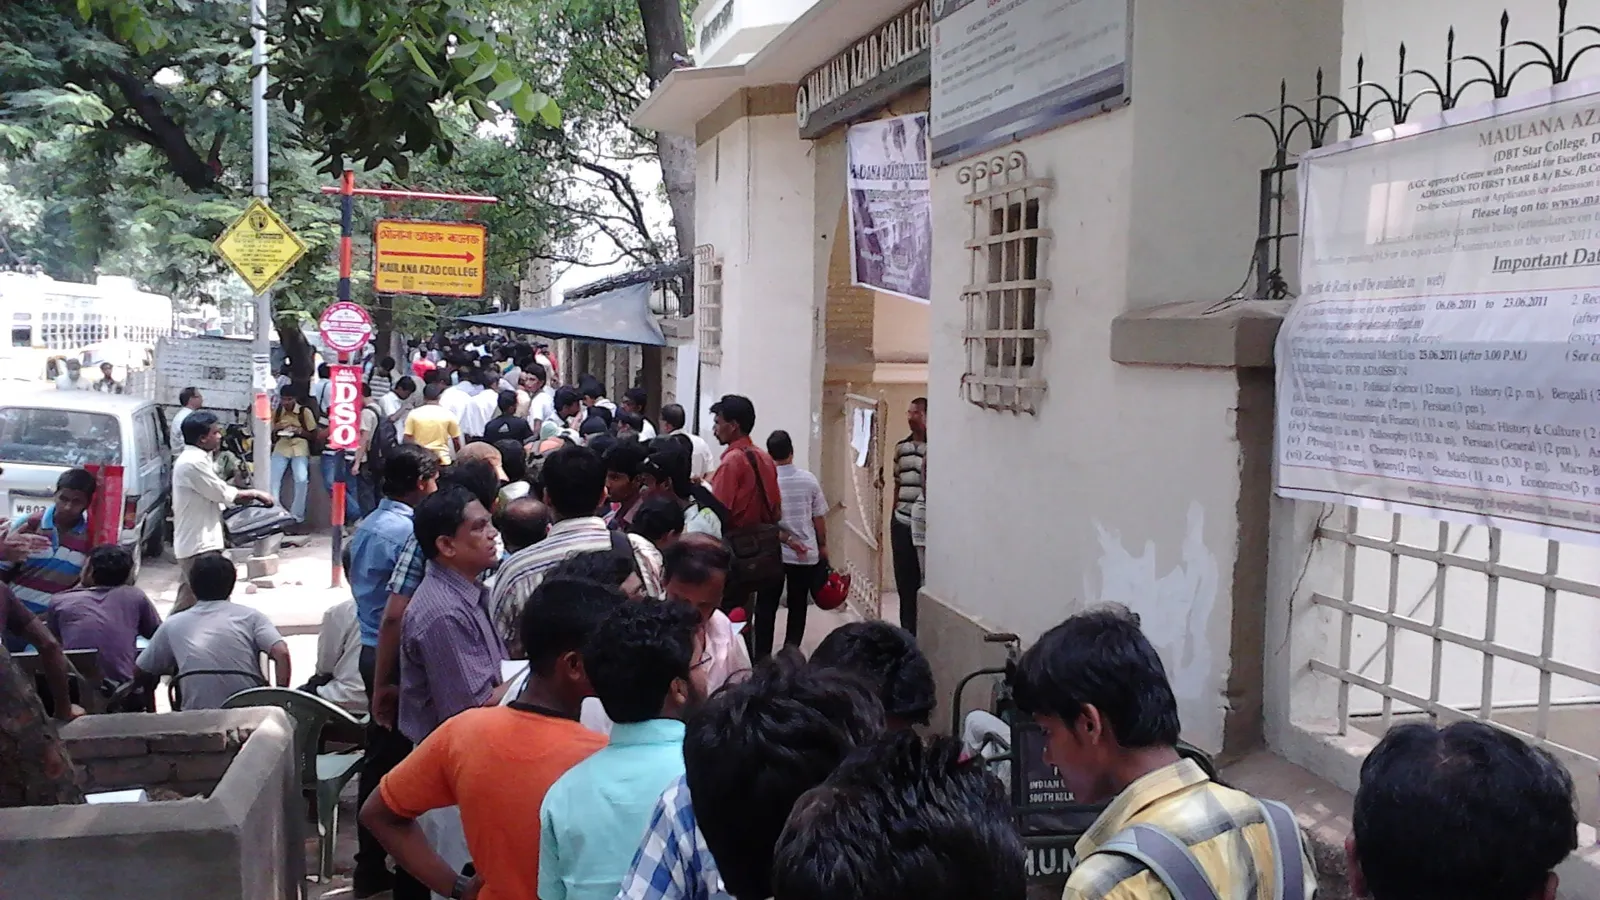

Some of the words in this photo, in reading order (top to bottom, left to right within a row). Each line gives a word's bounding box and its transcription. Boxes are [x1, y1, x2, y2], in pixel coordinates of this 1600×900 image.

[850, 35, 879, 89] AZAD
[1477, 116, 1566, 148] MAULANA
[1493, 146, 1521, 163] (DBT
[1522, 145, 1543, 157] Star
[1544, 137, 1588, 153] College,
[1486, 165, 1504, 177] with
[1505, 159, 1541, 174] Potential
[1542, 157, 1555, 167] for
[1421, 184, 1466, 199] ADMISSION
[1468, 182, 1480, 192] TO
[1480, 177, 1505, 190] FIRST
[1506, 174, 1531, 186] YEAR
[1492, 187, 1537, 203] Application
[1537, 187, 1550, 195] for
[1550, 180, 1594, 193] admission
[1471, 206, 1501, 220] Please
[1502, 204, 1519, 218] log
[1520, 202, 1534, 213] on
[1535, 200, 1549, 211] to:
[1491, 221, 1515, 233] basis
[1516, 215, 1574, 232] (attendance
[1577, 212, 1592, 223] on
[1525, 233, 1541, 246] the
[1543, 232, 1566, 246] year
[1568, 228, 1592, 242] 2011
[379, 262, 418, 274] MAULANA
[419, 264, 441, 276] AZAD
[442, 266, 479, 278] COLLEGE
[1491, 250, 1568, 274] Important
[1332, 279, 1351, 293] Rank
[1376, 274, 1407, 291] available
[1386, 303, 1427, 315] application
[1435, 298, 1477, 310] 06.06.2011
[1484, 299, 1494, 309] to
[1502, 295, 1549, 309] 23.06.2011
[1571, 311, 1600, 327] (after
[1459, 349, 1483, 363] (after
[1483, 349, 1502, 361] 3.00
[1345, 365, 1361, 376] FOR
[1361, 365, 1408, 377] ADMISSION
[1470, 385, 1501, 400] History
[1551, 386, 1588, 403] Bengali
[332, 382, 358, 446] DSO
[1422, 399, 1452, 412] Persian
[1465, 418, 1496, 432] Islamic
[1496, 421, 1532, 438] History
[1533, 424, 1542, 435] &
[1543, 423, 1581, 438] Culture
[1286, 434, 1301, 445] (v)
[1446, 450, 1500, 466] Mathematics
[1462, 435, 1494, 449] Persian
[1431, 464, 1468, 479] Statistics
[1495, 499, 1546, 516] application
[1029, 779, 1060, 790] INDIAN
[1029, 792, 1054, 803] SOUTH
